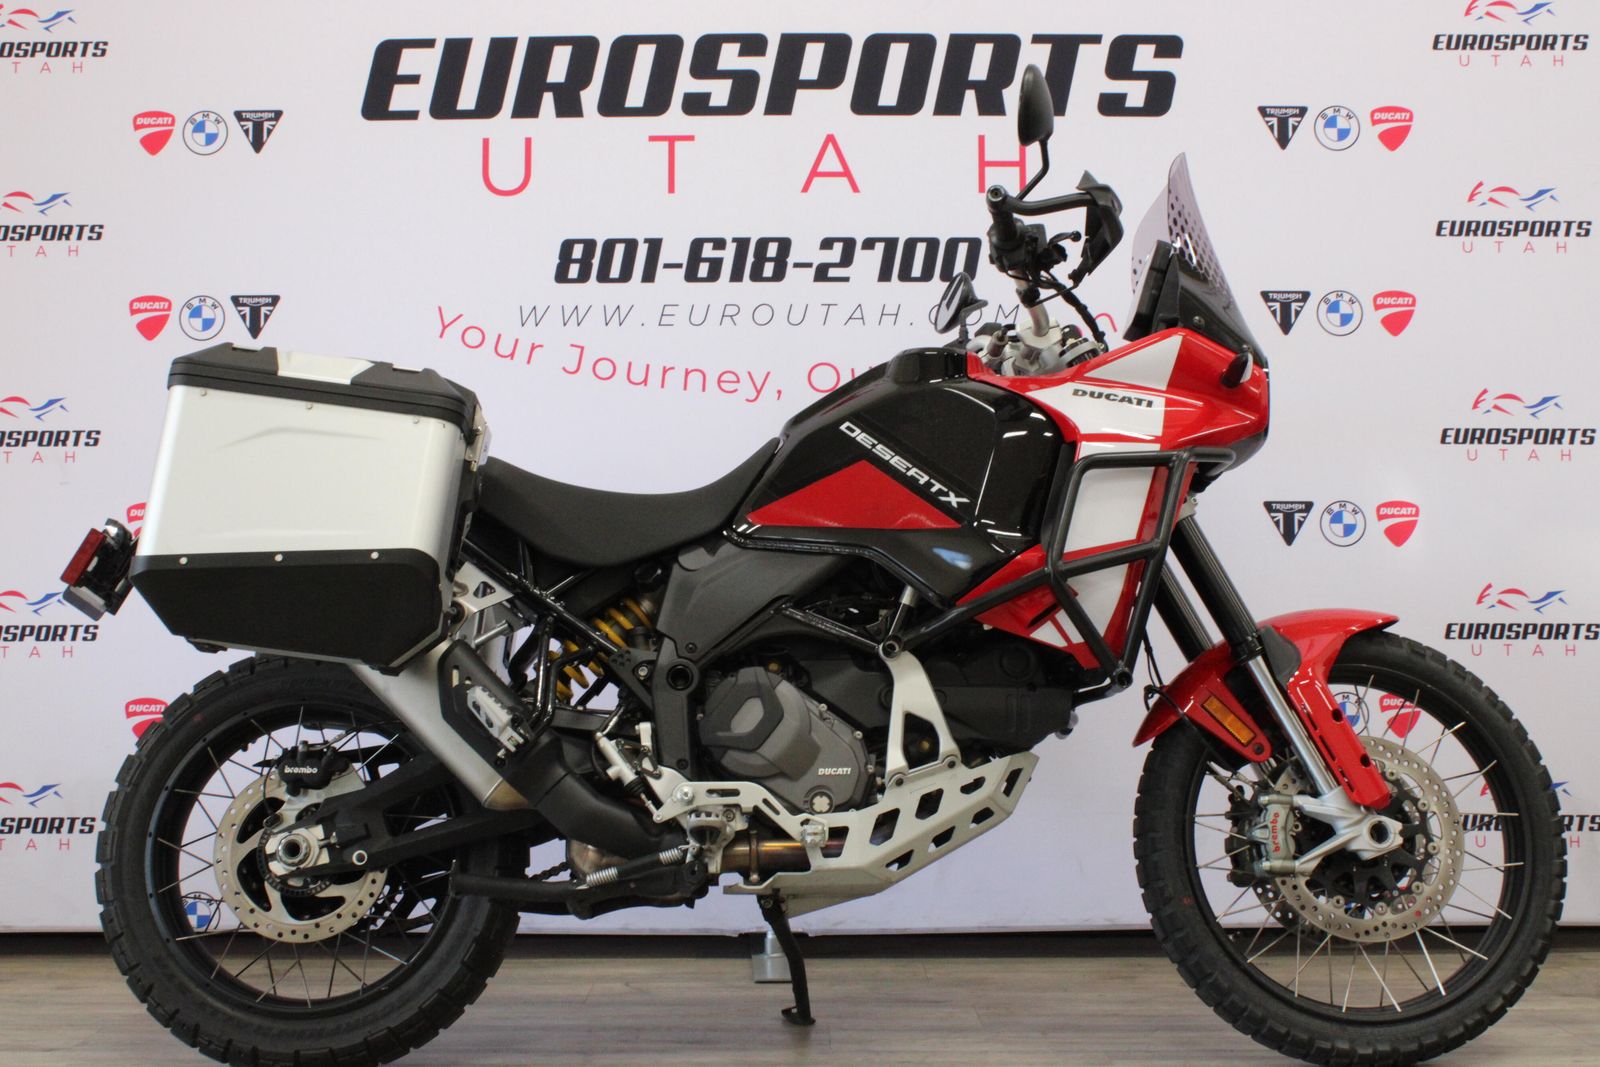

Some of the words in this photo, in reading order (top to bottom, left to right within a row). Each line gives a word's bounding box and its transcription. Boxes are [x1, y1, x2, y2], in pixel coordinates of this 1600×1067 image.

[1432, 34, 1589, 51] EUROSPORTS
[1459, 55, 1564, 67] UTAH
[361, 33, 1184, 120] EUROSPORTS
[189, 113, 223, 125] BMW
[1320, 108, 1354, 120] BMW
[1373, 112, 1410, 120] DUCATI
[136, 117, 173, 125] DUCATI
[483, 134, 1026, 196] UTAH
[1435, 220, 1592, 237] EUROSPORTS
[1462, 241, 1567, 254] UTAH
[554, 237, 982, 284] 801-618-2700
[186, 298, 219, 310] BMW
[1322, 293, 1357, 305] BMW
[1376, 297, 1413, 305] DUCATI
[132, 302, 169, 310] DUCATI
[438, 306, 544, 365] Your
[562, 343, 782, 403] Journey,
[1072, 388, 1154, 408] DUCATI
[1440, 428, 1597, 445] EUROSPORTS
[1467, 448, 1572, 461] UTAH
[839, 421, 970, 508] DESERTX
[1326, 504, 1360, 515] BMW
[1379, 507, 1416, 515] DUCATI
[0, 625, 99, 641] SPORTS
[1444, 623, 1600, 640] EUROSPORTS
[1471, 643, 1576, 656] UTAH
[284, 766, 318, 774] brembo
[818, 767, 852, 776] DUCATI
[1270, 812, 1280, 853] brembo
